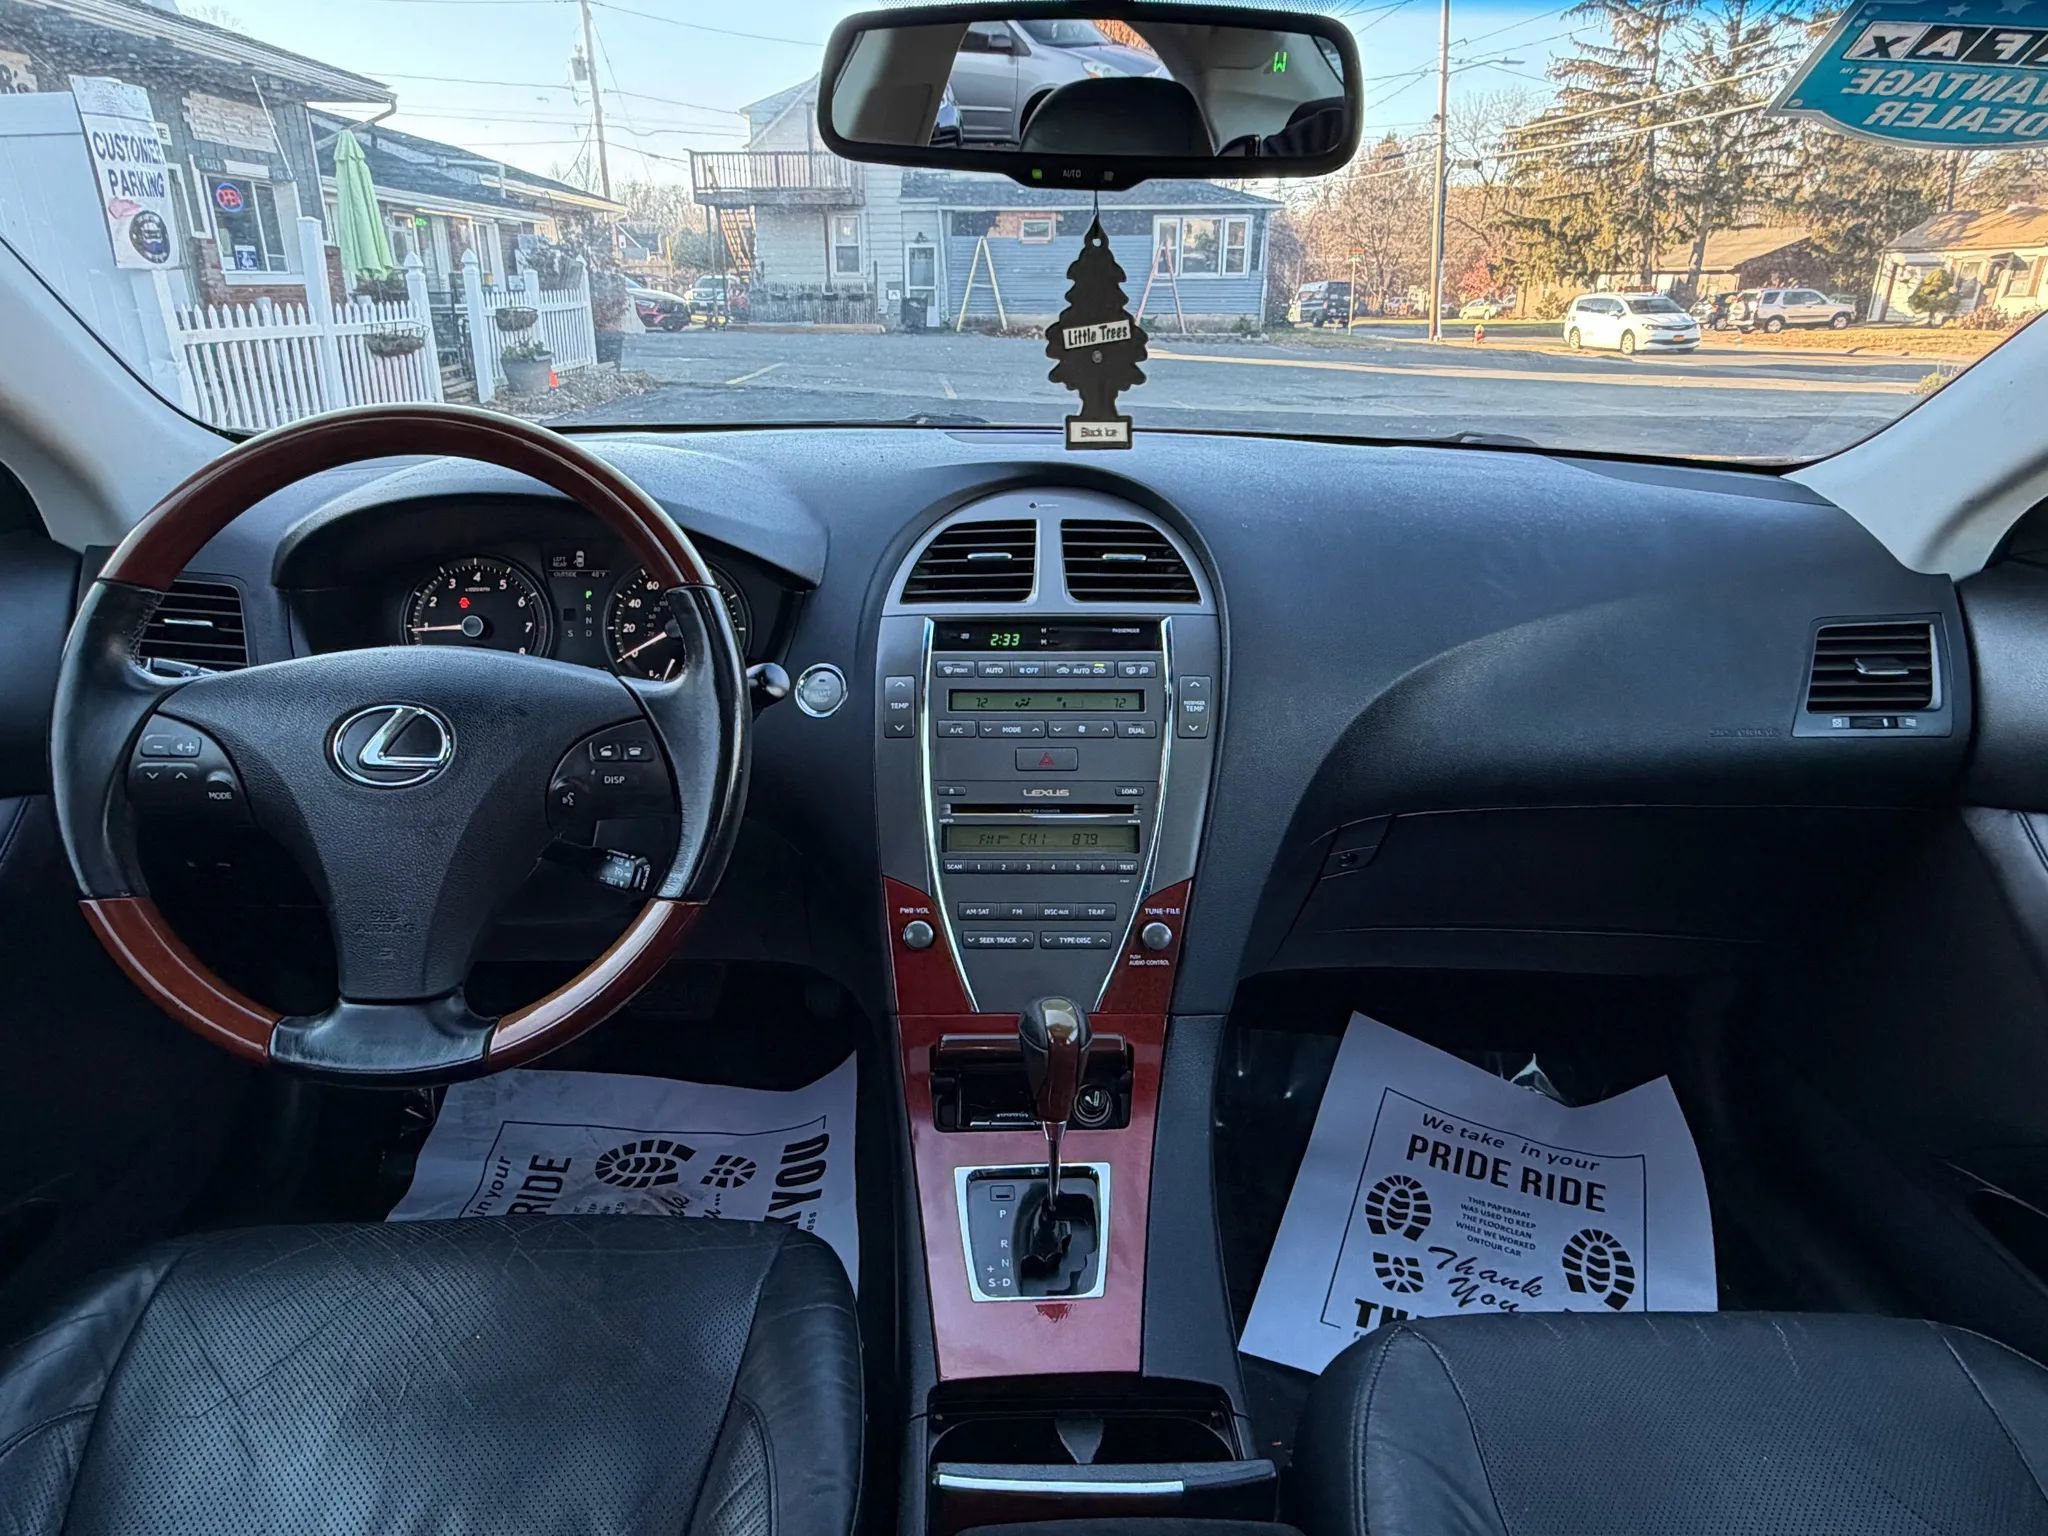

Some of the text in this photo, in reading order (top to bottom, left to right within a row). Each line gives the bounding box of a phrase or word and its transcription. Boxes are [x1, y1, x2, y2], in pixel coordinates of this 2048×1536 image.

[1273, 51, 1287, 72] W
[93, 131, 165, 165] CUSTOMER
[1062, 169, 1081, 178] AUTO
[108, 168, 165, 198] PARKING
[1068, 325, 1128, 346] Little Trees
[1081, 427, 1101, 438] Black
[473, 572, 481, 582] 4
[448, 579, 456, 589] 3
[499, 580, 507, 590] 5
[646, 582, 660, 591] 60
[585, 590, 593, 599] P
[429, 597, 438, 607] 2
[518, 598, 526, 608] 6
[628, 599, 642, 609] 40
[585, 604, 592, 612] R
[525, 622, 533, 633] 7
[622, 623, 636, 633] 20
[585, 630, 593, 638] D
[990, 633, 1020, 646] 2:33
[1128, 727, 1146, 735] DUAL
[604, 776, 625, 784] DISP
[208, 791, 232, 800] MODE
[1423, 1113, 1601, 1171] We take in your
[1406, 1134, 1606, 1213] PRIDE RIDE
[469, 1155, 512, 1217] in your
[506, 1154, 572, 1215] RIDE
[1468, 1196, 1531, 1219] THIS PAPERMAT
[999, 1209, 1007, 1218] P
[1460, 1203, 1537, 1229] WAS USED TO KEEP
[1462, 1213, 1477, 1223] THE
[1456, 1220, 1536, 1250] WHILE WE WORKED
[1000, 1239, 1008, 1248] R
[1504, 1246, 1522, 1257] CAR
[1001, 1258, 1010, 1268] N
[1427, 1246, 1543, 1298] Thank
[1448, 1277, 1519, 1313] You
